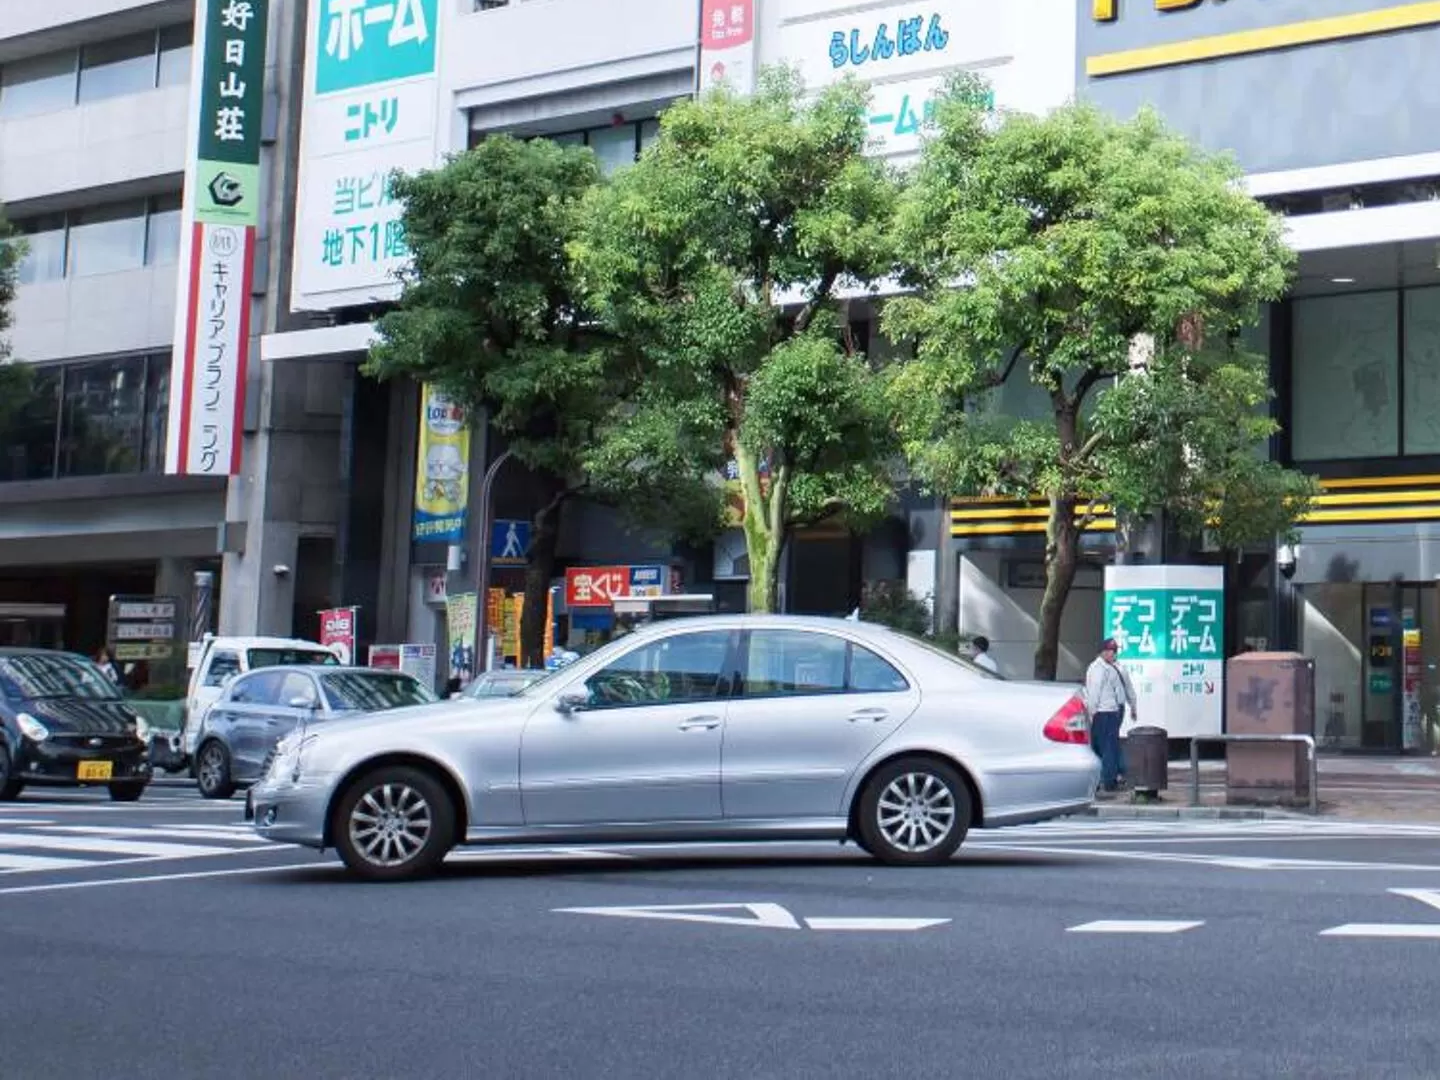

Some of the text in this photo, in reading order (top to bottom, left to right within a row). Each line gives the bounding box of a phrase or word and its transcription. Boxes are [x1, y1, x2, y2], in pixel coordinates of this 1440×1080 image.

[829, 13, 950, 69] らしんばん
[345, 96, 398, 141] ニトリ
[573, 572, 623, 602] 宝くじ
[1112, 595, 1155, 625] デコ
[1170, 595, 1216, 626] デコ
[1111, 624, 1157, 655] ホーム
[1170, 624, 1217, 655] ホーム
